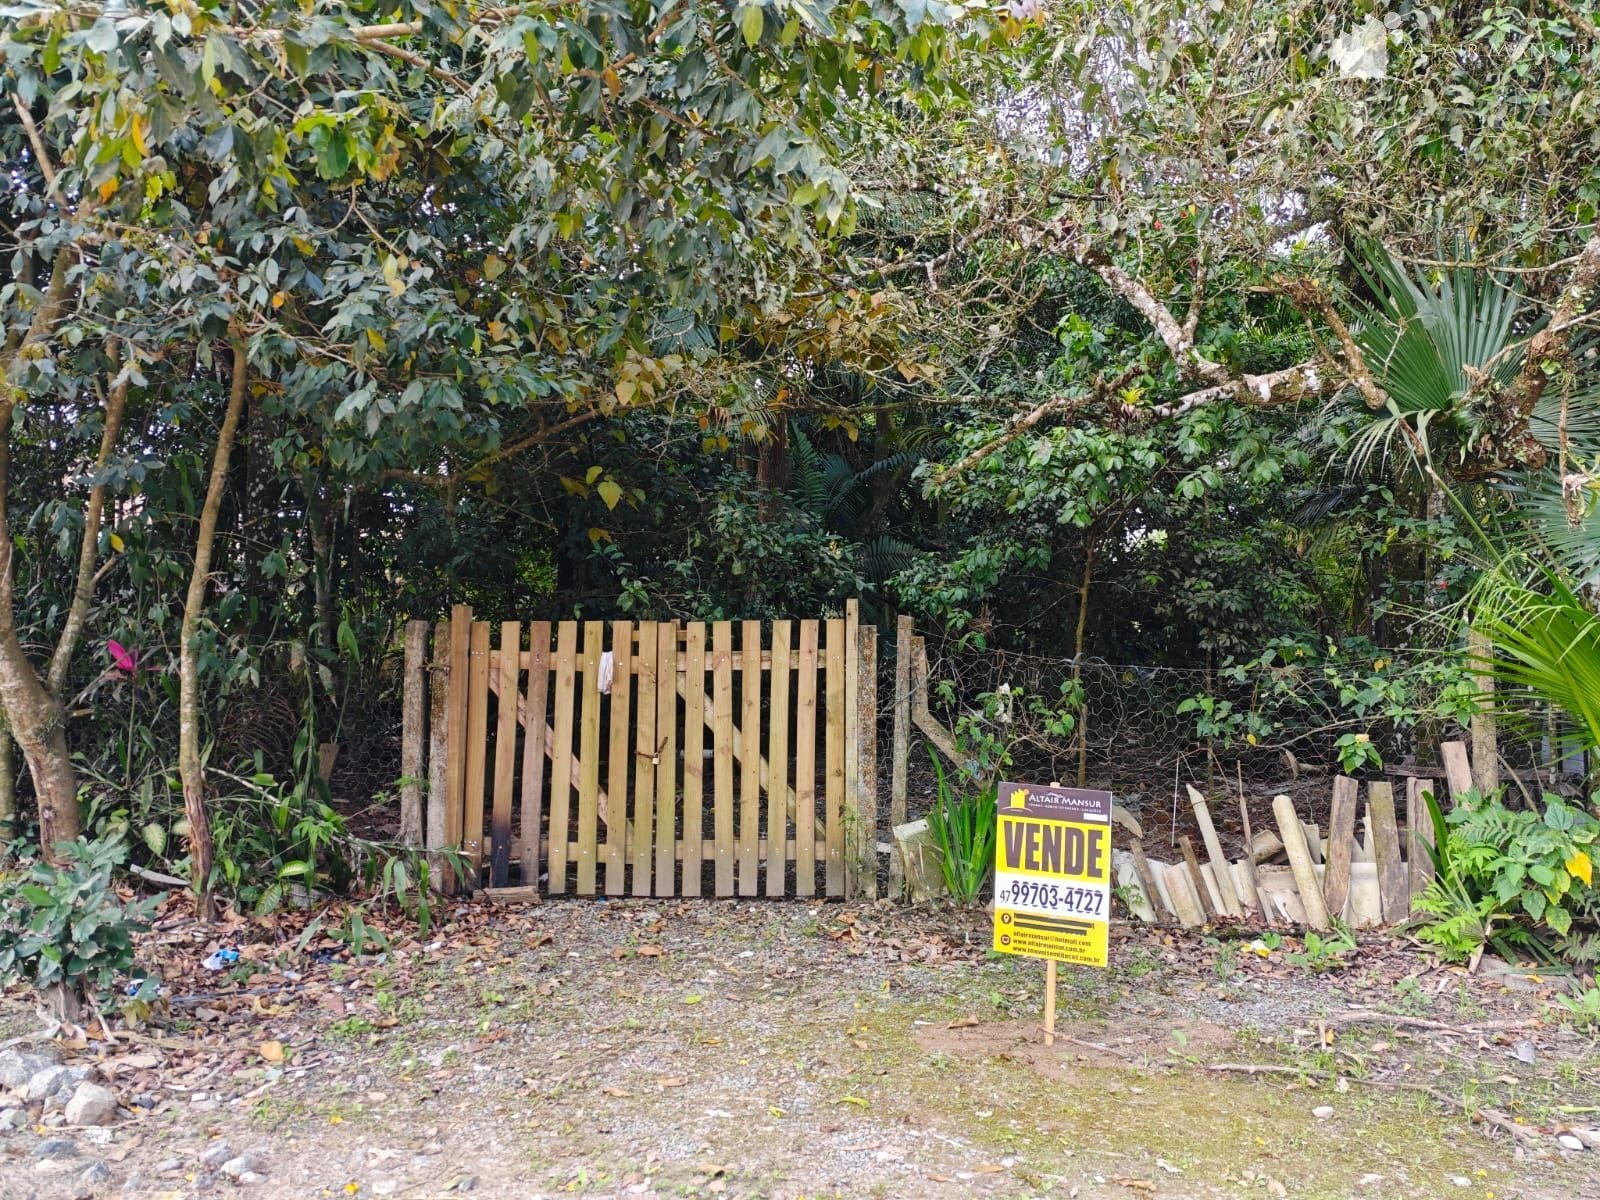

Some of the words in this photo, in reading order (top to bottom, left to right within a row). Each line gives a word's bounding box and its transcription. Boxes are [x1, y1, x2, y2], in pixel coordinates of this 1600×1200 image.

[1028, 793, 1059, 805] ALTAIR
[1061, 797, 1101, 808] MANSUR
[1003, 820, 1103, 878] VENDE
[999, 889, 1011, 903] 47
[1011, 881, 1104, 914] 99703-4727
